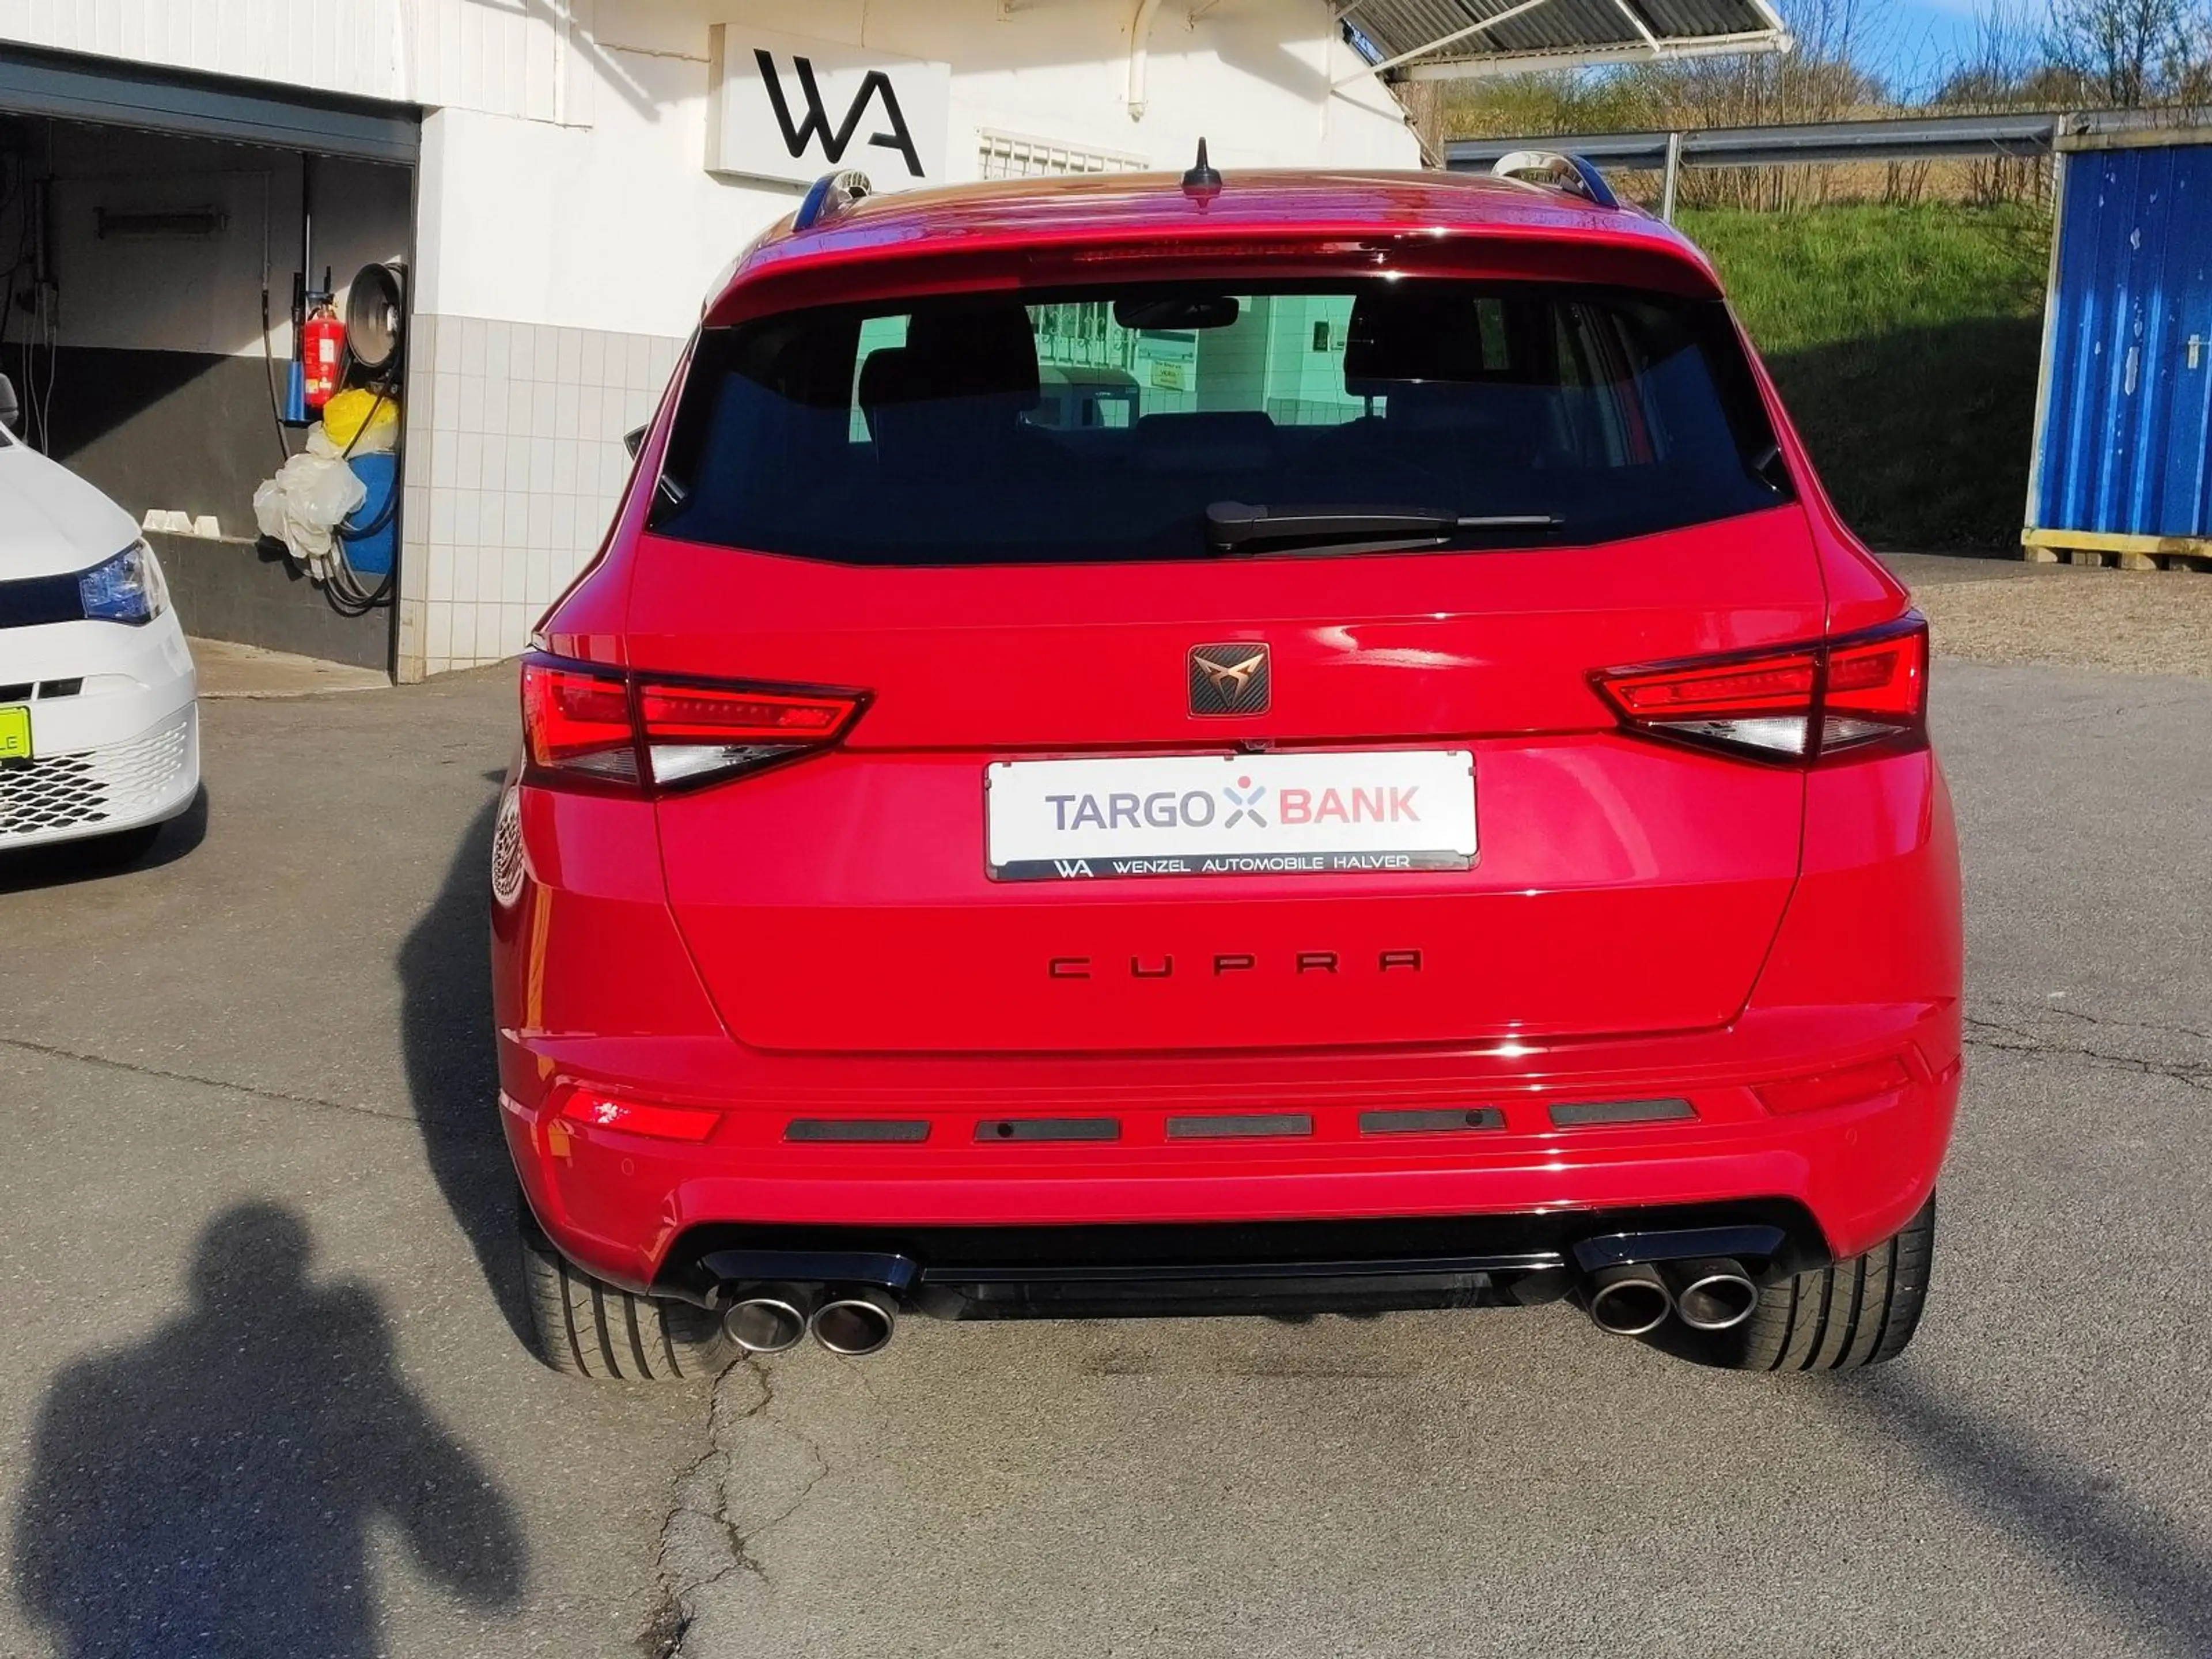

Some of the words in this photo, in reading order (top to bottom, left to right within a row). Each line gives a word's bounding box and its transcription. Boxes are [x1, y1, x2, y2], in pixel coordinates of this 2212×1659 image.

[753, 48, 925, 177] WA
[1046, 791, 1215, 830] TARGO
[1280, 786, 1421, 824] BANK
[1054, 859, 1094, 878] WA
[1113, 860, 1191, 873] WENZEL
[1202, 857, 1324, 872] AUTOMOBILE
[1334, 855, 1410, 869] HALVER
[1048, 949, 1421, 979] CUPRA
